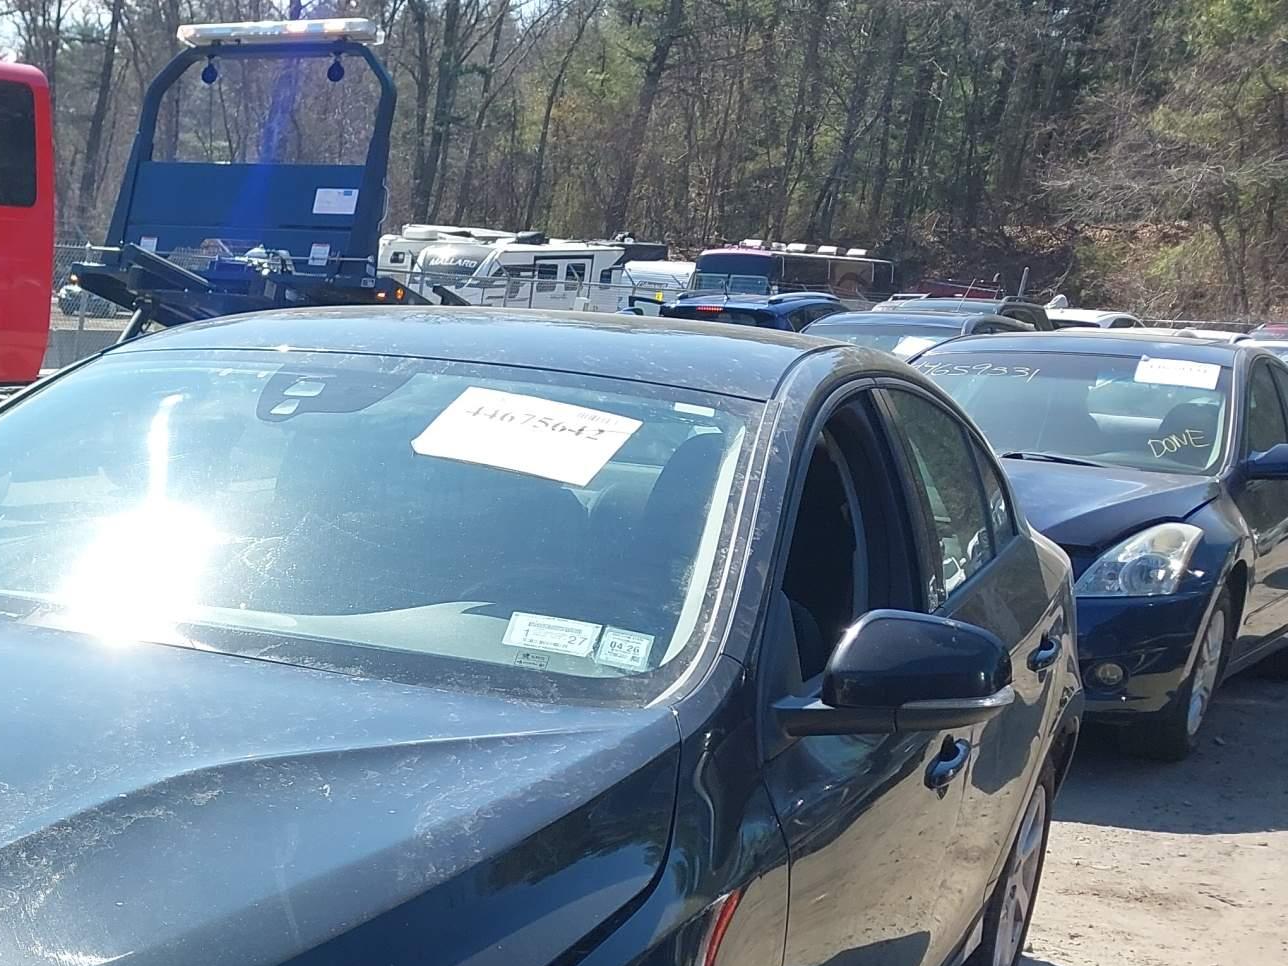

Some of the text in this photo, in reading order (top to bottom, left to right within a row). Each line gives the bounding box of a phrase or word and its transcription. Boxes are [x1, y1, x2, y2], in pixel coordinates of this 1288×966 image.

[429, 257, 478, 268] MALLARD
[465, 405, 606, 441] 44675642
[1148, 429, 1210, 458] DONE
[567, 635, 588, 646] 27
[609, 640, 623, 650] 04
